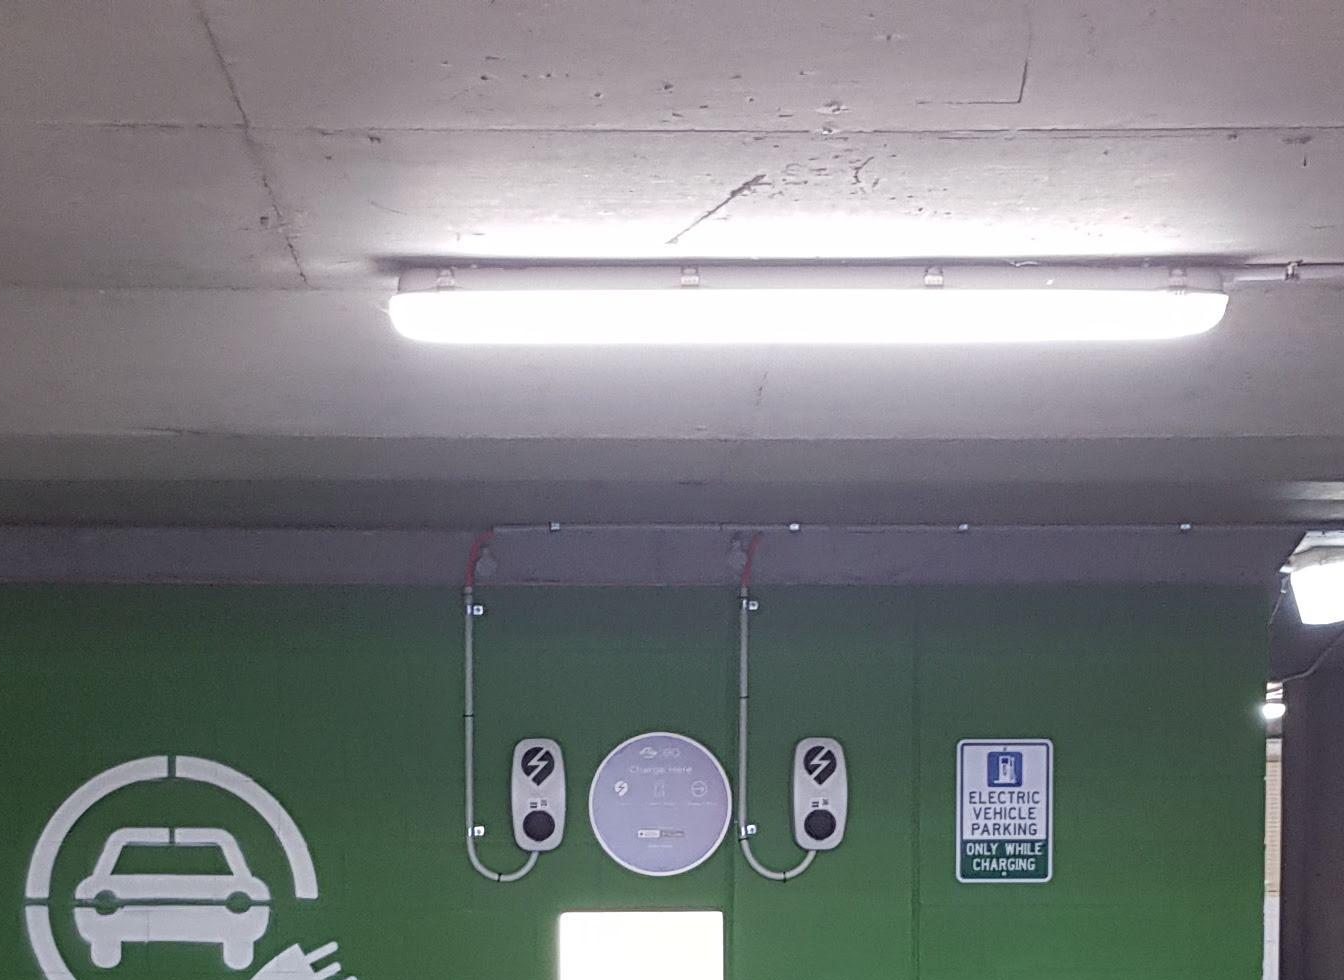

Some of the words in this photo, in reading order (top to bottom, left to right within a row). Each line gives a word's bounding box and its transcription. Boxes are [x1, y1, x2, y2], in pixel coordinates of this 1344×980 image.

[969, 791, 1041, 805] ELECTRIC
[973, 807, 1037, 820] VEHICLE
[971, 823, 1038, 836] PARKING
[966, 843, 999, 856] ONLY
[1005, 842, 1043, 855] WHILE
[972, 858, 1036, 871] CHARGING
